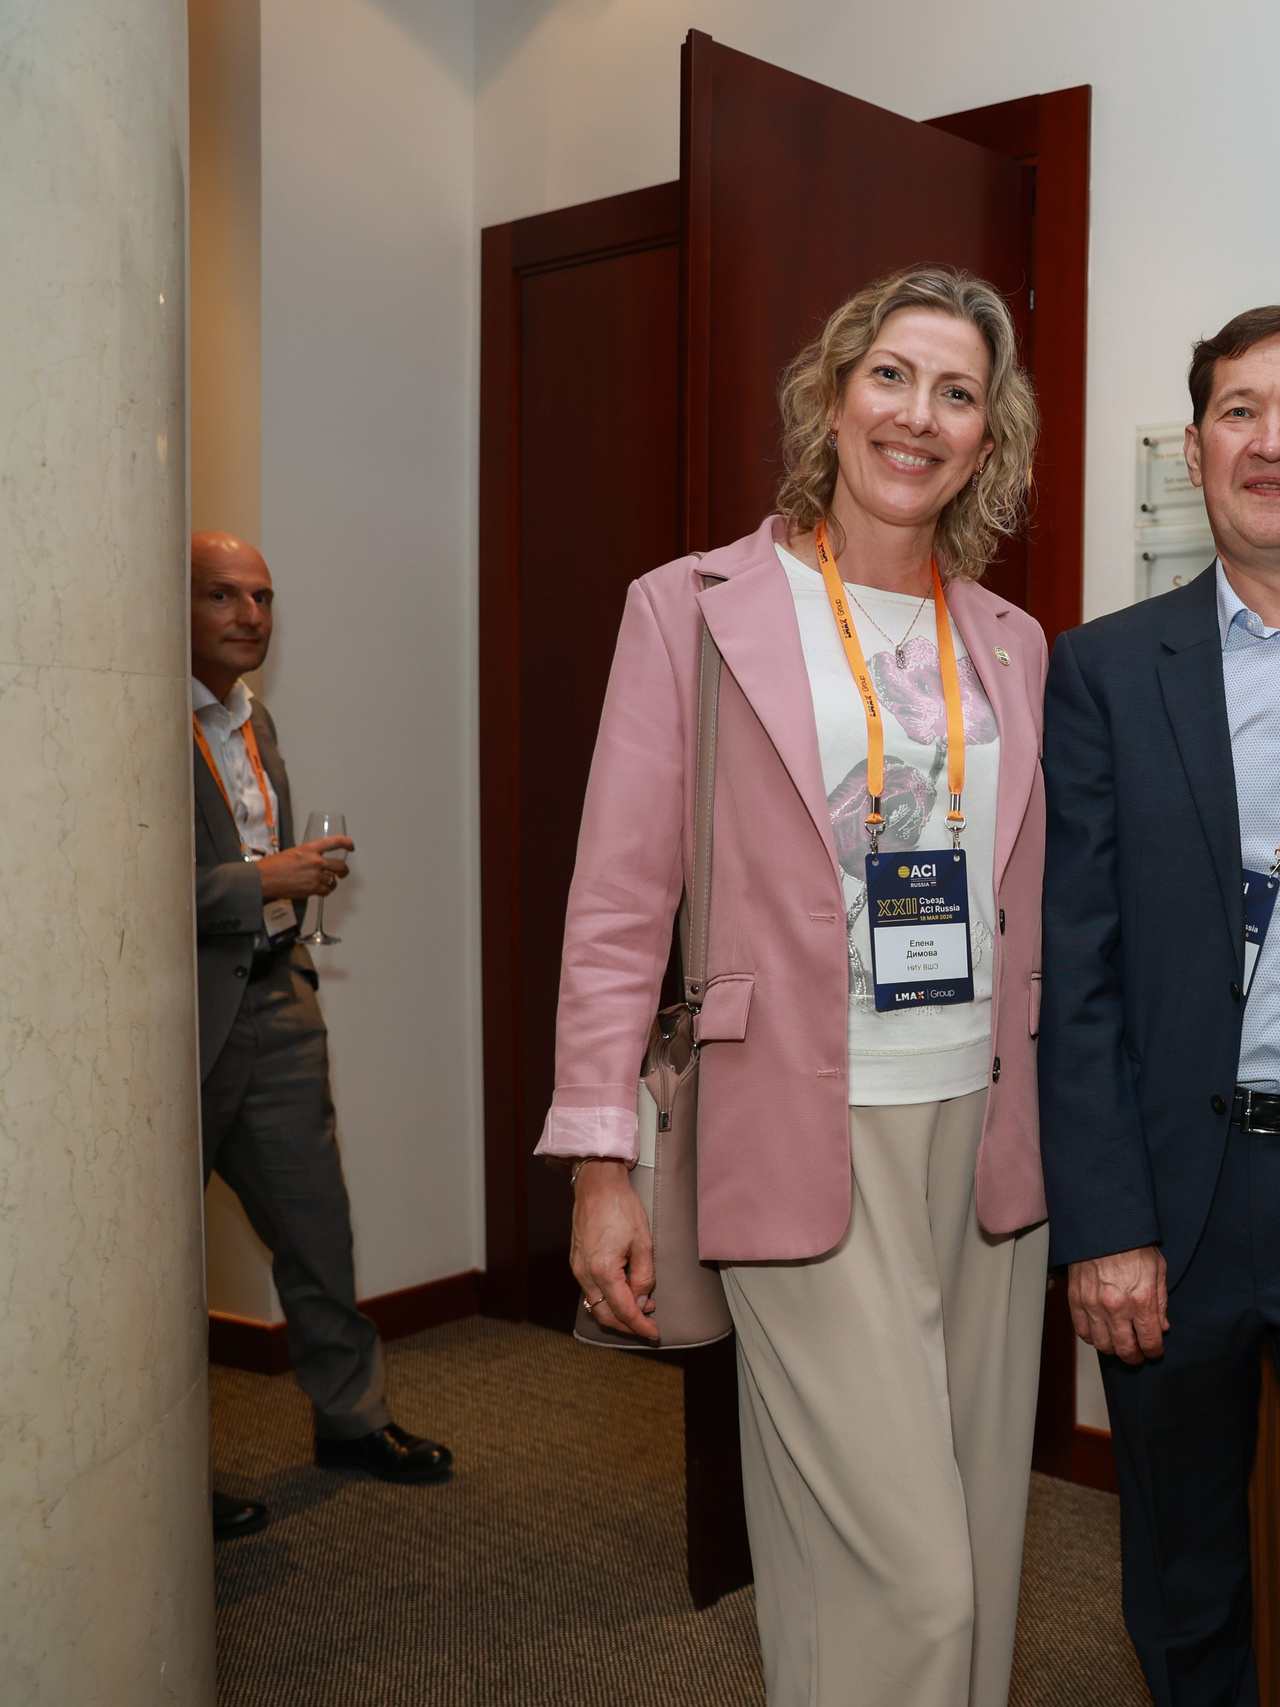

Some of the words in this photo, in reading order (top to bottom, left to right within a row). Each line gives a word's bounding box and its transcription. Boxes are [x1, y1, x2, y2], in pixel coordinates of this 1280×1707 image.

[818, 542, 828, 564] LMAX
[835, 598, 845, 616] Group
[840, 618, 852, 638] LMAX
[859, 675, 869, 692] Group
[865, 695, 876, 717] LMAX
[910, 864, 937, 878] ACI
[877, 897, 918, 917] XXII
[919, 897, 945, 905] Съезд
[920, 906, 934, 914] ACI
[935, 904, 960, 913] Russia
[909, 939, 934, 948] Елена
[906, 950, 938, 959] Димова
[923, 962, 939, 971] ВШЭ
[895, 991, 925, 1002] LMAX
[930, 989, 955, 998] Group
